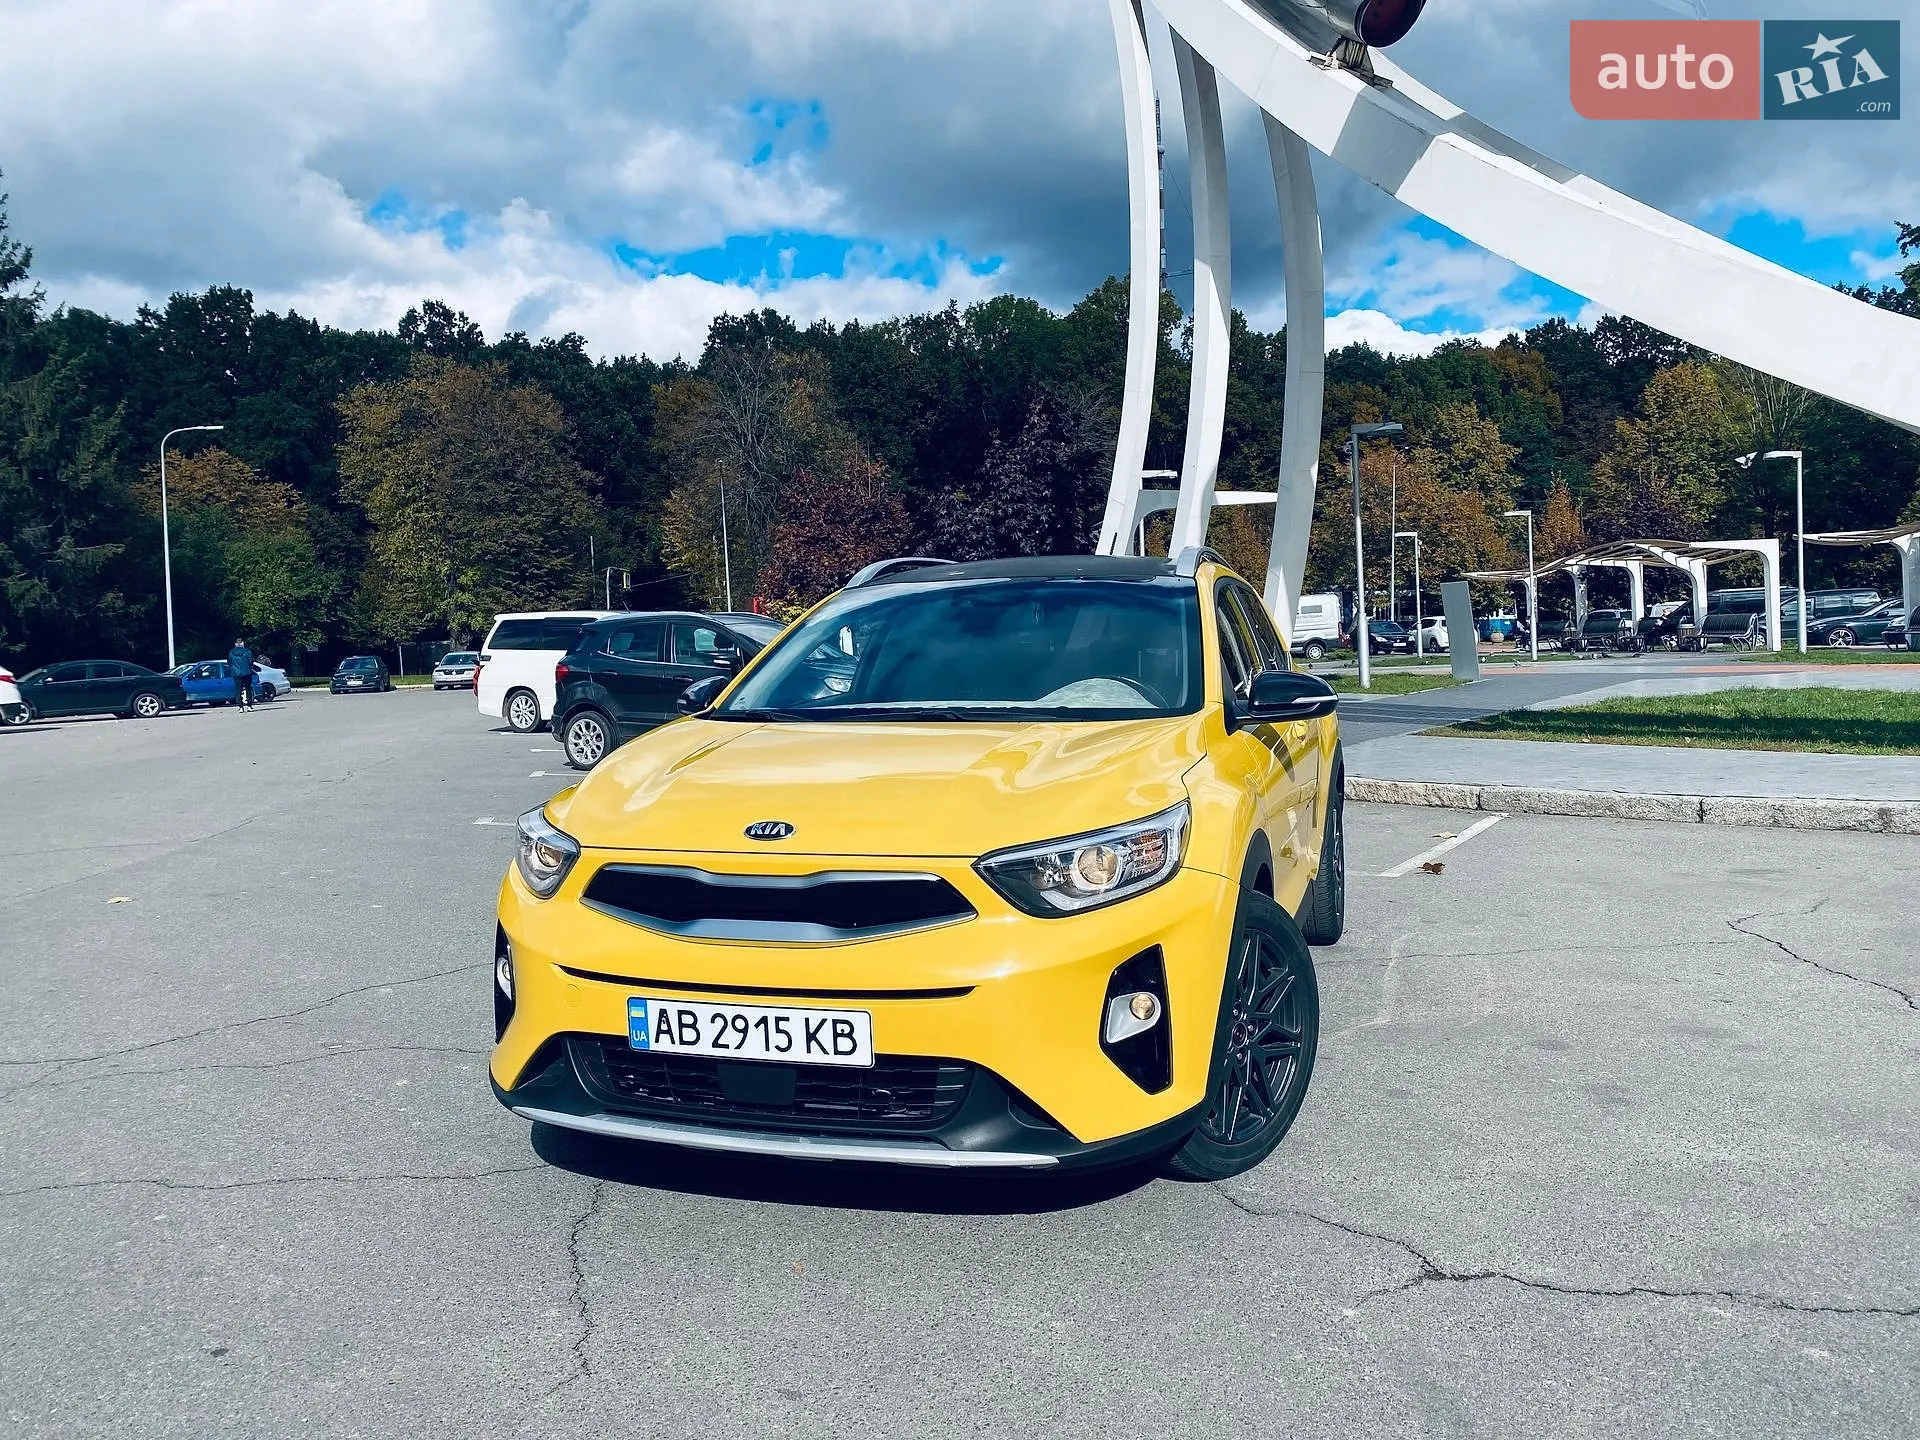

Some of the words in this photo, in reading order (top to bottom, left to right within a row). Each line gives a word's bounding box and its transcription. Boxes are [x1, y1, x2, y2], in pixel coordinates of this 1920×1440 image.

[750, 823, 786, 836] KIA
[632, 1030, 648, 1042] UA
[654, 1008, 701, 1046] AB
[710, 1012, 793, 1053] 2915
[804, 1017, 858, 1056] KB
